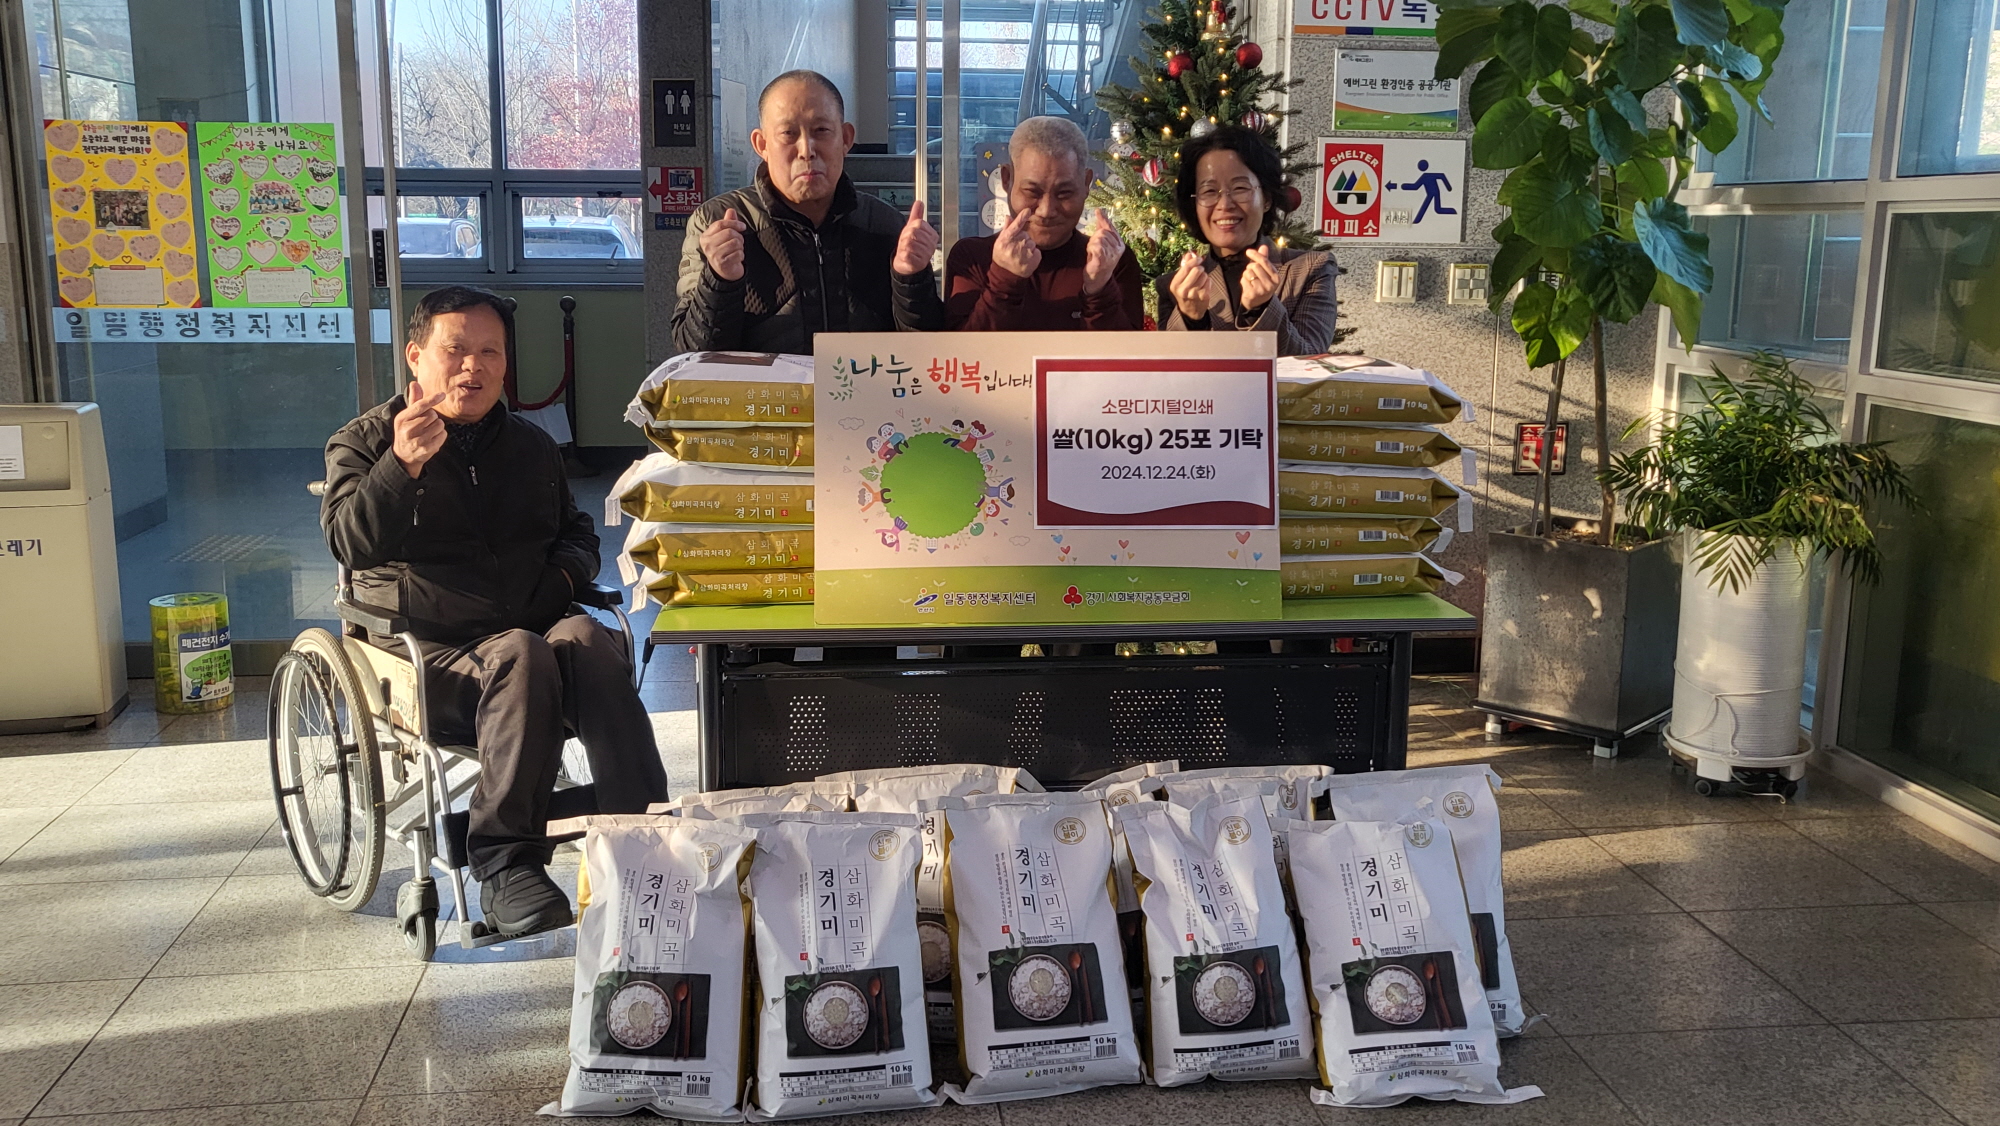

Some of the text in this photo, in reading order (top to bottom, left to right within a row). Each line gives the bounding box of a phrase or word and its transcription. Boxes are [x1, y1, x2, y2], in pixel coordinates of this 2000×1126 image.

[1343, 78, 1377, 89] 에버그린
[1381, 79, 1414, 89] 환경인증
[244, 126, 289, 136] 이웃에게
[82, 135, 109, 144] 소중하고
[234, 140, 308, 151] 사랑을 나눠요
[1329, 150, 1380, 168] SHELTER
[663, 192, 701, 205] 소화전
[1323, 219, 1378, 236] 대피소
[850, 354, 1033, 398] 나눔은 행복입니다!
[681, 396, 730, 405] 삼화미곡처리장
[1101, 398, 1213, 415] 소망디지털인쇄
[1418, 401, 1428, 410] kg
[744, 404, 786, 417] 경기미
[1311, 404, 1349, 415] 경기미
[1052, 427, 1263, 453] 쌀(10kg) 25포 기탁
[748, 446, 789, 459] 경기미
[1308, 445, 1346, 456] 경기미
[1101, 465, 1216, 482] 2024.12.24.(화)
[736, 492, 790, 503] 삼화미곡
[1308, 494, 1346, 507] 경기미
[1417, 494, 1427, 502] kg
[734, 507, 775, 519] 경기미
[1291, 538, 1330, 550] 경기미
[746, 553, 786, 566] 경기미
[1394, 574, 1405, 582] kg
[762, 586, 802, 599] 경기미
[1287, 583, 1325, 594] 경기미
[943, 592, 1036, 605] 일동행정복지센터
[1086, 591, 1190, 605] 경기 사회복지공동모금회
[1015, 847, 1036, 914] 경기미
[1036, 851, 1066, 932] 삼화미곡
[1191, 862, 1217, 921] 경기미
[1361, 858, 1389, 923] 경기미
[1387, 851, 1419, 943] 삼화미곡
[638, 873, 664, 936] 경기미
[817, 868, 838, 937] 경기미
[1211, 859, 1248, 937] 삼화미곡
[844, 867, 867, 957] 삼화미곡
[662, 878, 691, 960] 삼화미곡
[1094, 1037, 1116, 1045] 10 kg
[903, 1065, 912, 1073] kg
[1034, 1065, 1085, 1077] 삼화미곡처리장
[699, 1075, 711, 1083] kg
